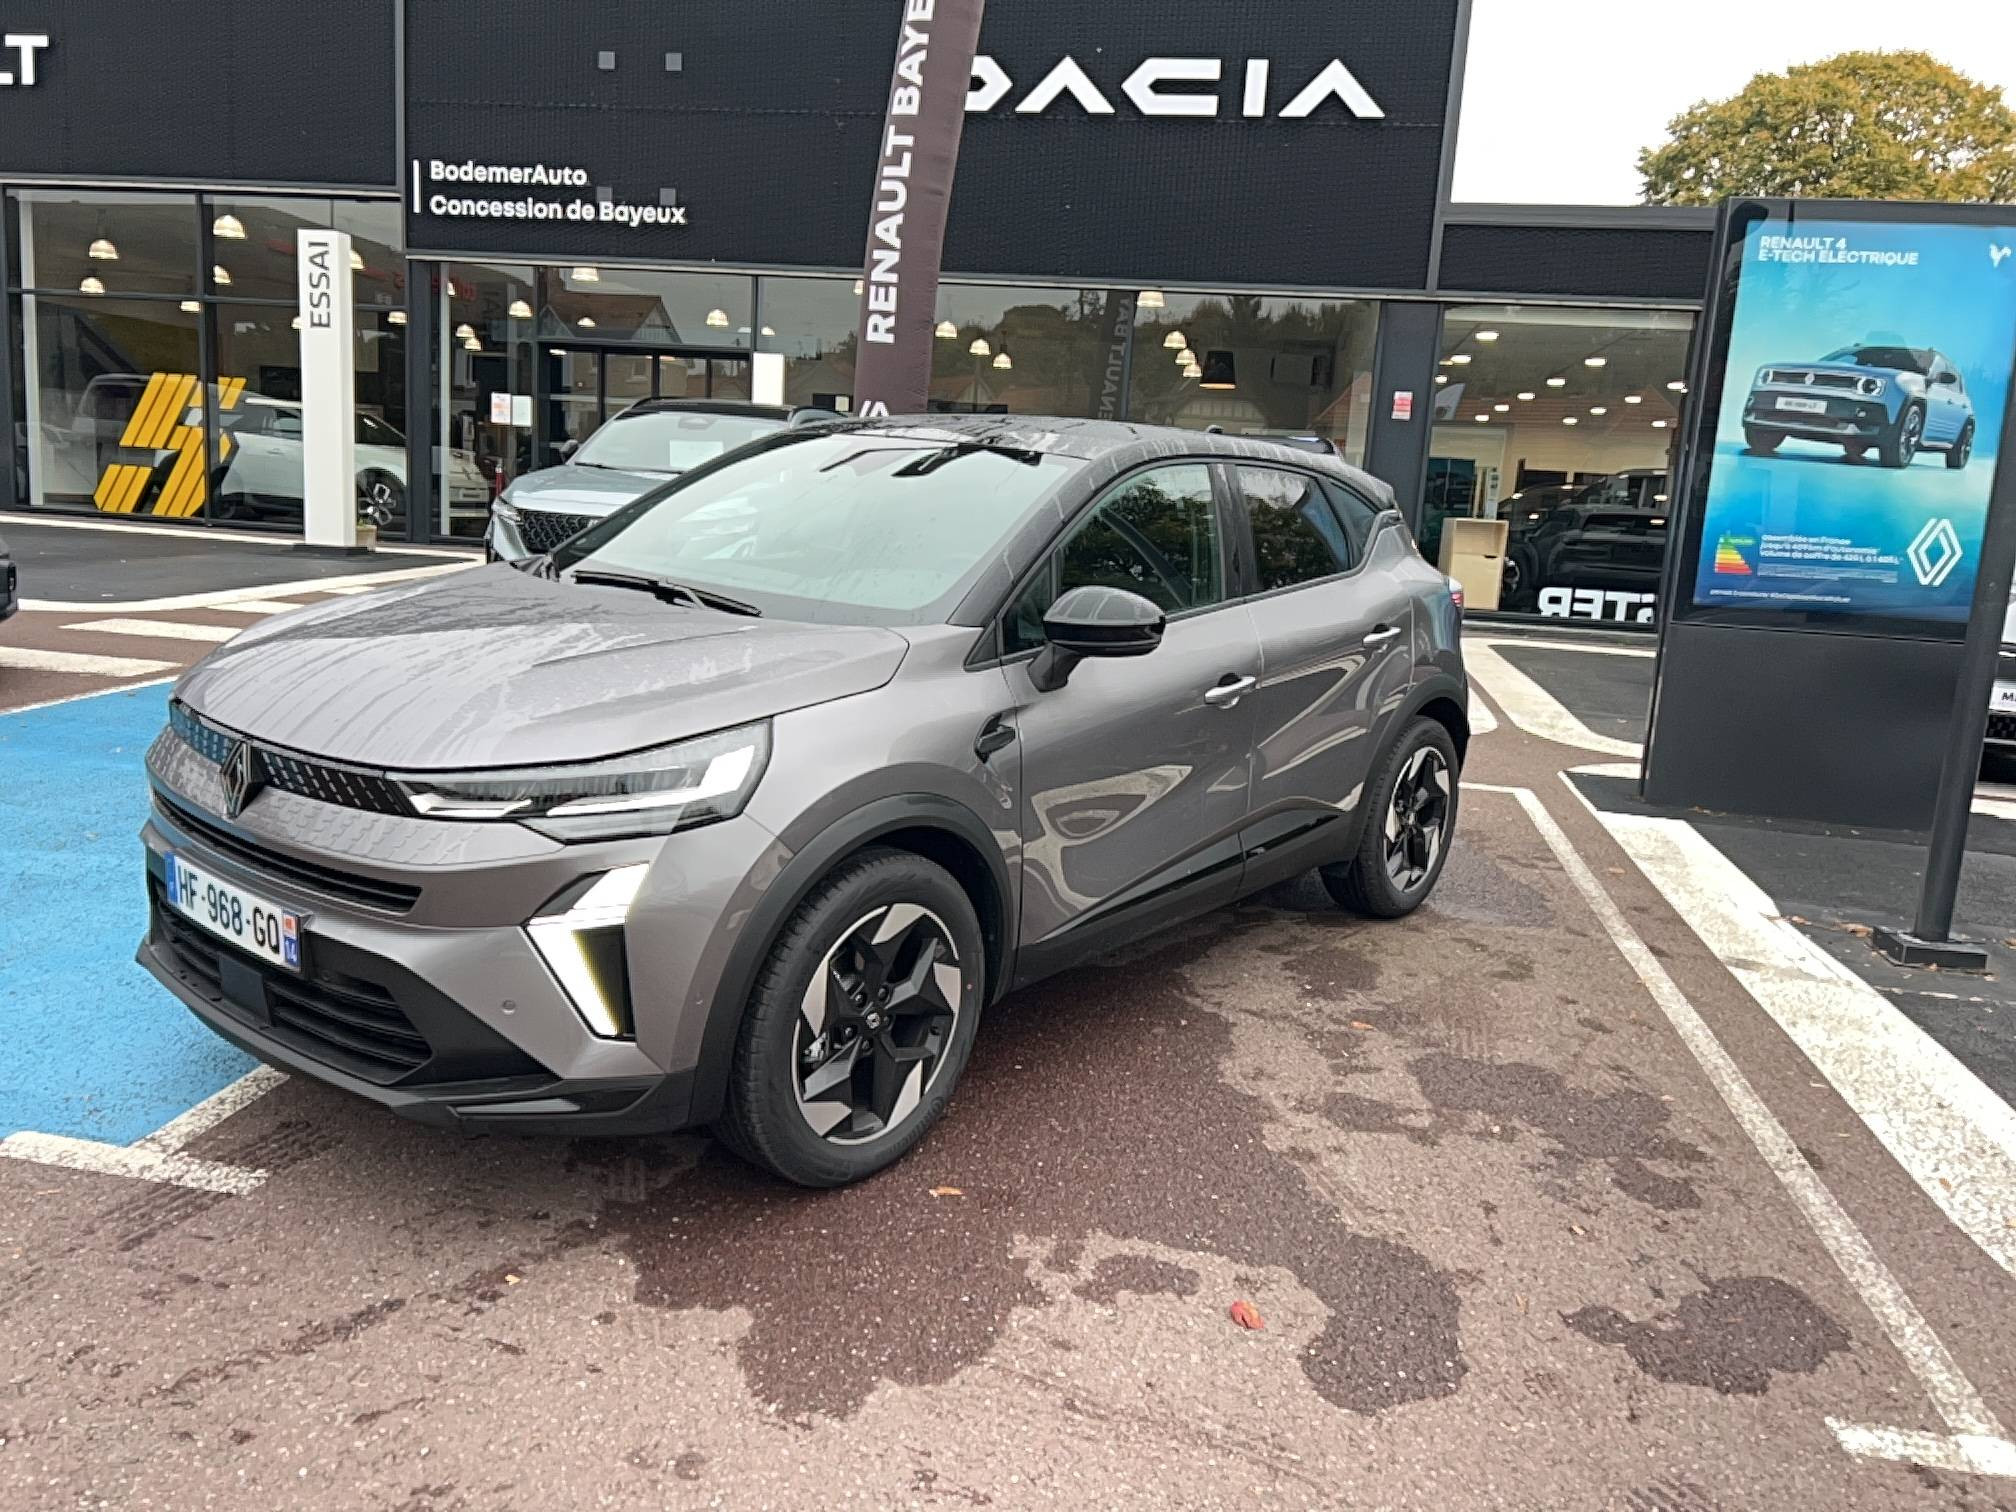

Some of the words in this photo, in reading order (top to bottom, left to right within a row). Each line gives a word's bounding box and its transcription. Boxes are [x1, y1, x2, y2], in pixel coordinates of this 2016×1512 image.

[430, 160, 588, 186] BodemerAuto
[430, 195, 565, 220] Concession
[566, 199, 596, 221] de
[598, 201, 687, 227] Bayeux
[866, 125, 915, 344] RENAULT
[1760, 236, 1834, 250] RENAULT
[1836, 238, 1847, 250] 4
[1758, 249, 1817, 263] E-TECH
[307, 240, 332, 329] ESSAI
